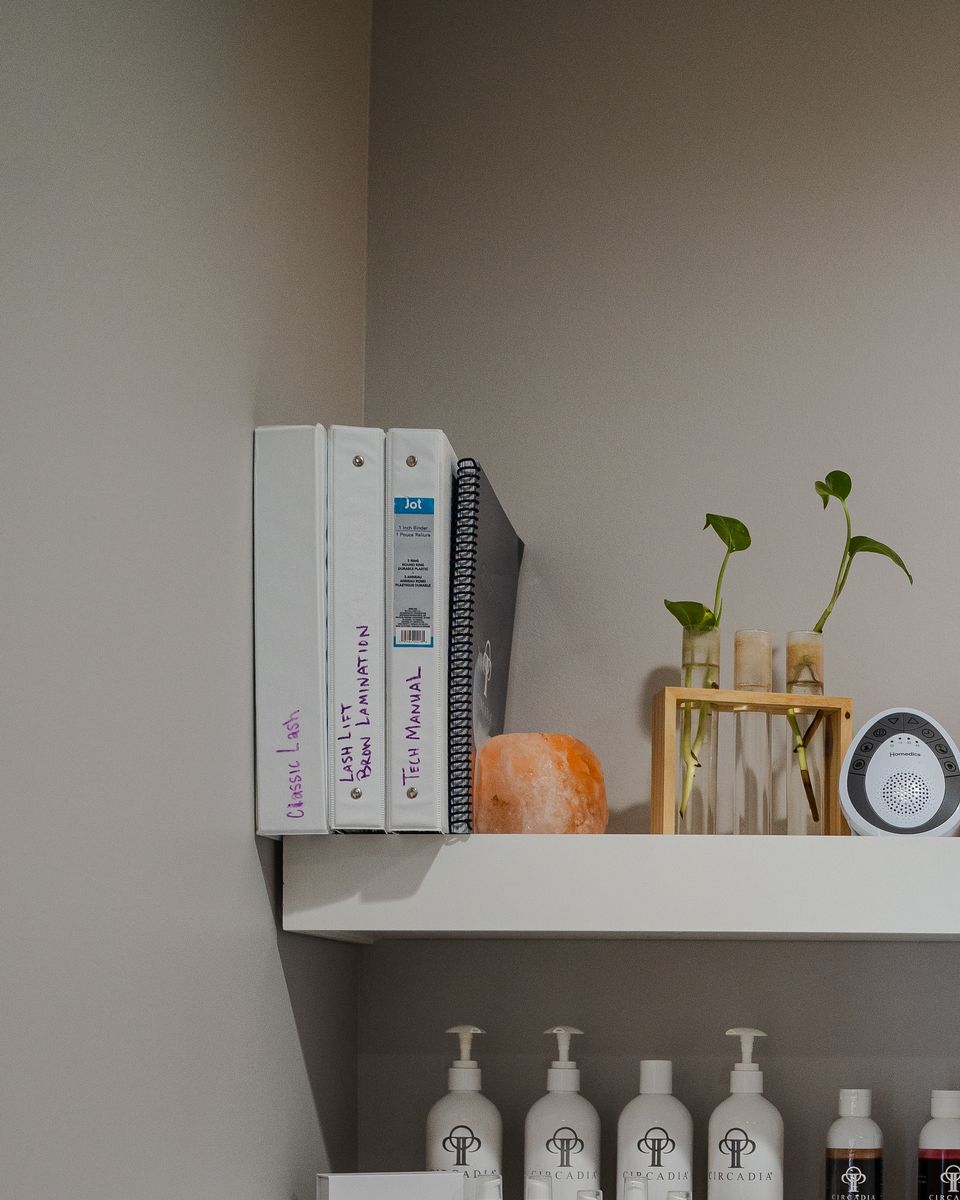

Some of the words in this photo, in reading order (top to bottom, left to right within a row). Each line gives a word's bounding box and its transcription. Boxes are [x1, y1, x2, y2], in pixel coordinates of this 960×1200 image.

[404, 498, 422, 510] Jot
[354, 625, 371, 727] LAMINATION
[337, 703, 352, 741] LIFT
[404, 666, 421, 741] MANUAL
[339, 745, 354, 782] LASH
[356, 736, 372, 781] BROW
[402, 747, 420, 786] TECH
